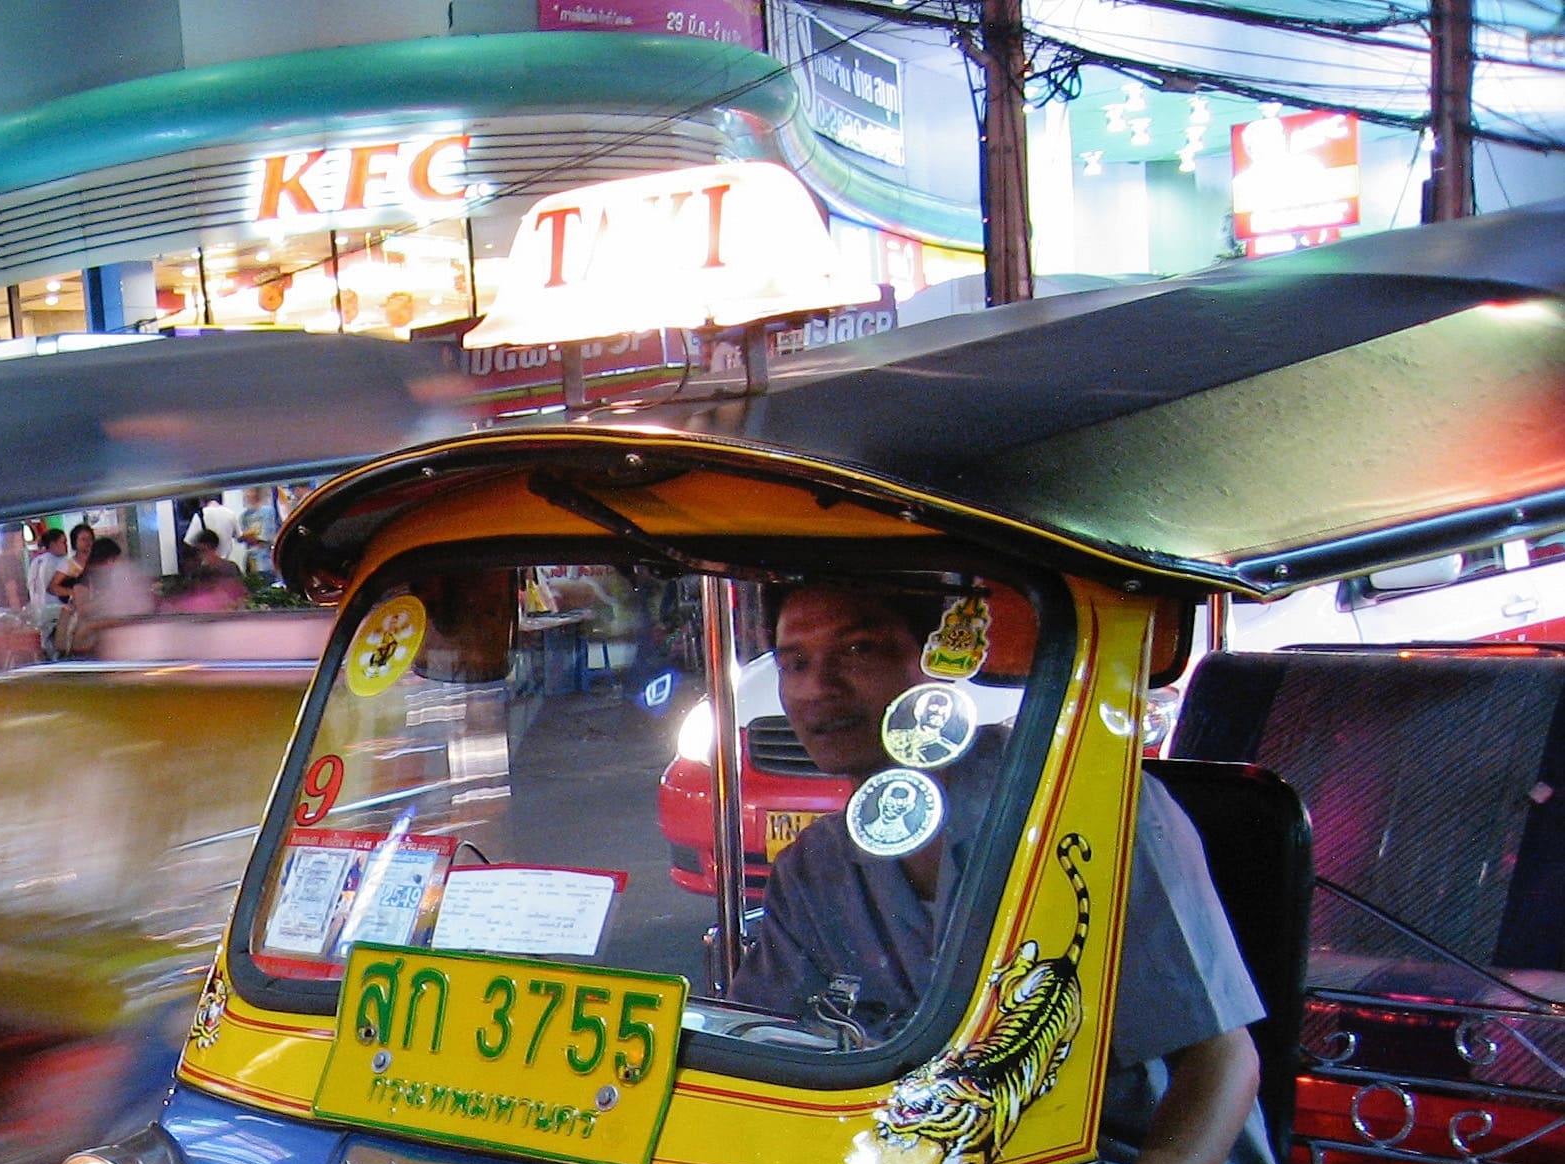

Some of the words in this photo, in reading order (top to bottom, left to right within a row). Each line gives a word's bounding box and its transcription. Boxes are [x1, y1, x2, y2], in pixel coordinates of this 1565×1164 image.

[257, 136, 471, 221] KFC
[294, 754, 344, 826] 9
[356, 957, 450, 1055] สก
[475, 974, 664, 1086] 3755
